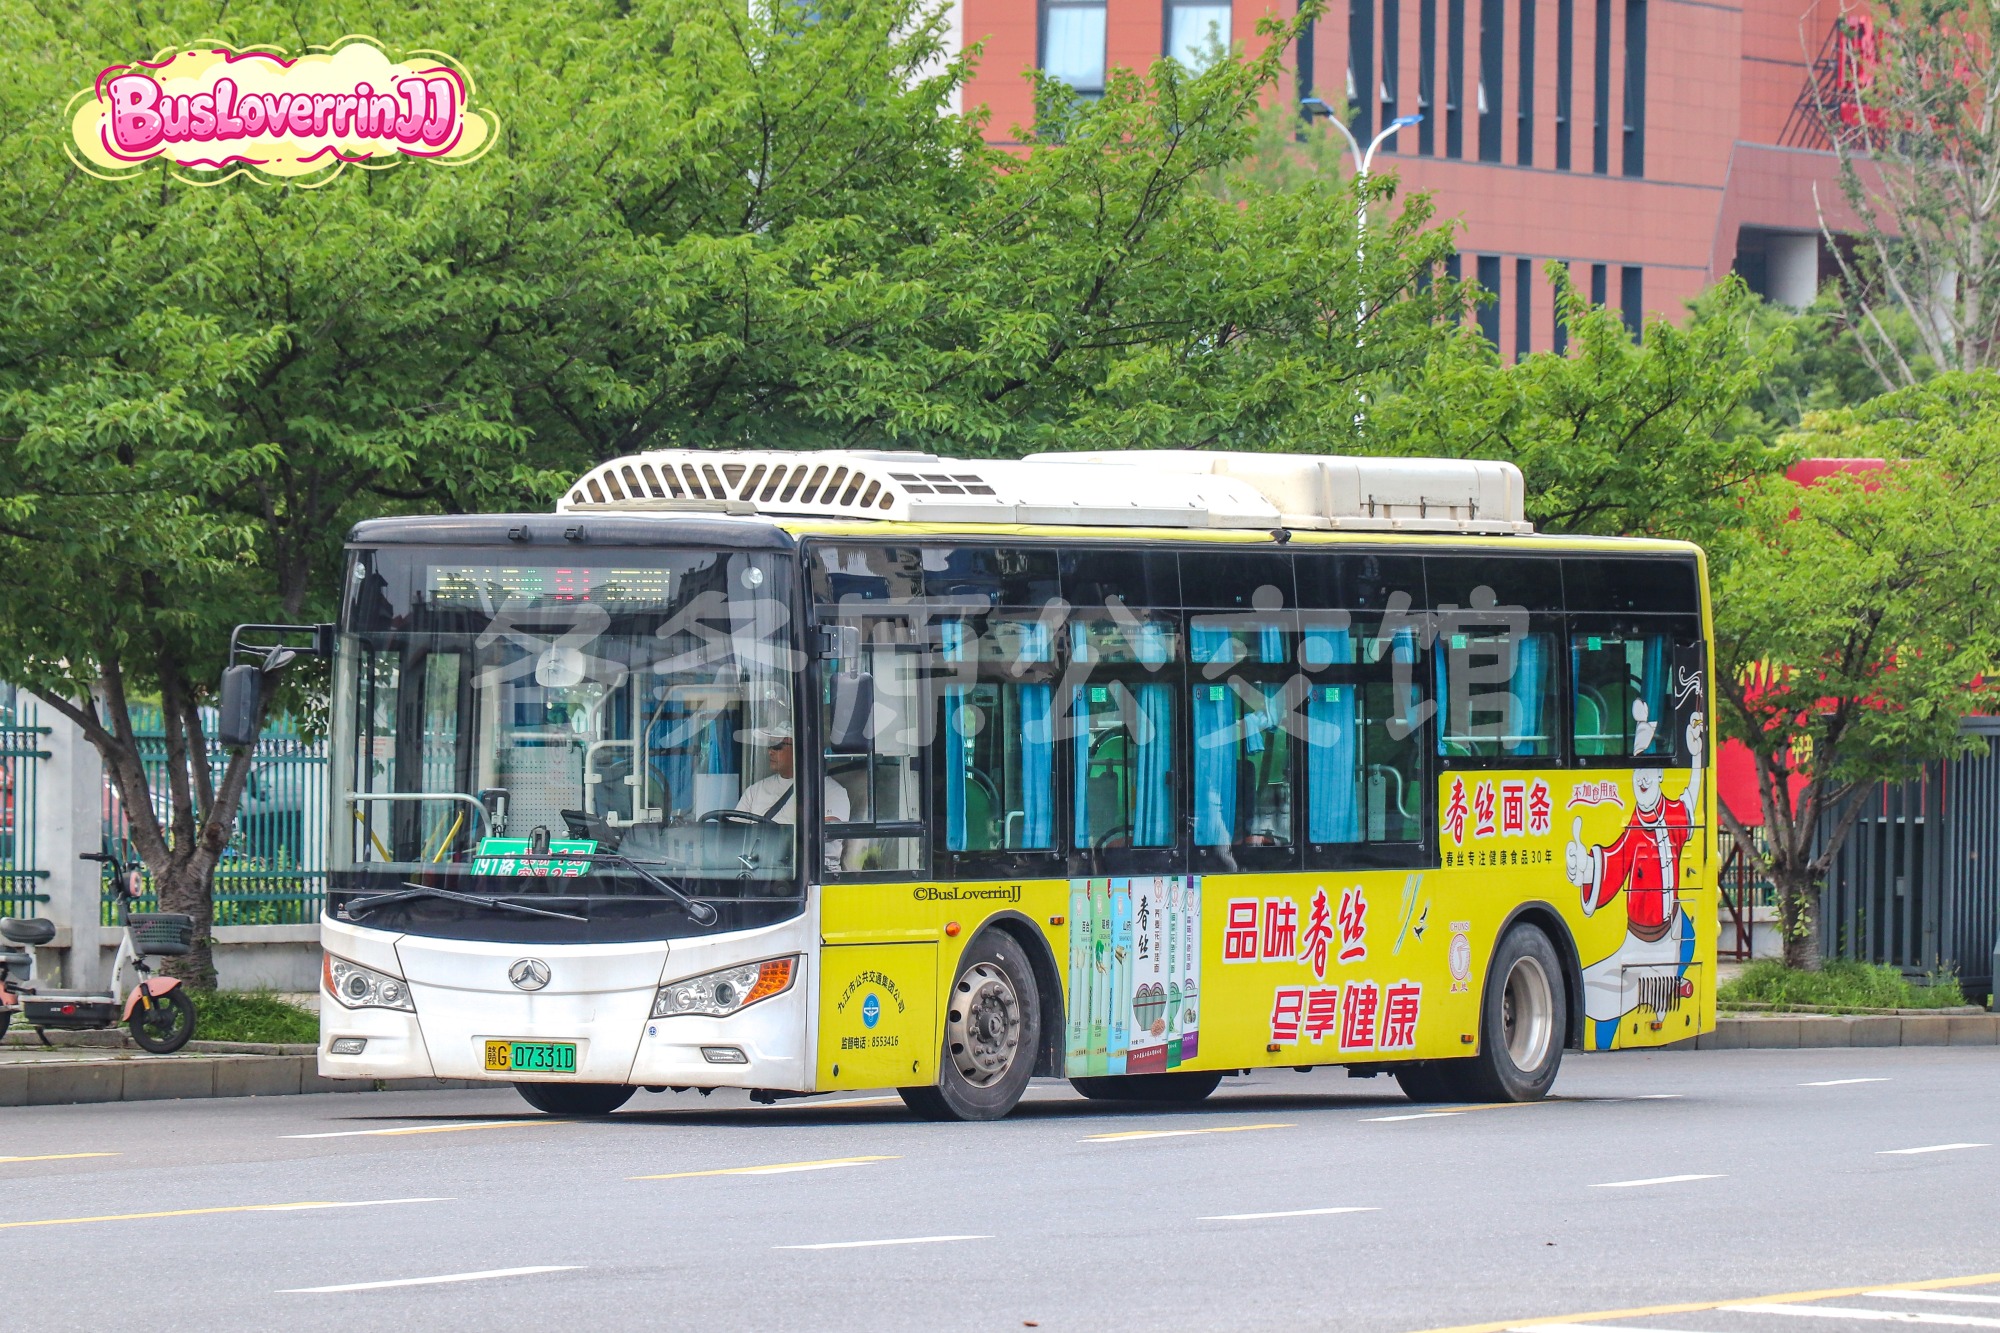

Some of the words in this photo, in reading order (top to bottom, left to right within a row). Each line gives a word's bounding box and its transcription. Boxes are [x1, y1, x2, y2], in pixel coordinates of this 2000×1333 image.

[1442, 777, 1552, 845] 春丝面条
[1573, 782, 1619, 800] 不加食用胶
[1446, 849, 1553, 867] 春丝专注健康食品30年
[1135, 894, 1151, 960] 春丝
[1224, 888, 1367, 979] 品味春丝
[837, 969, 906, 1015] 九江市公共交通集团公司
[1271, 983, 1421, 1048] 尽享健康
